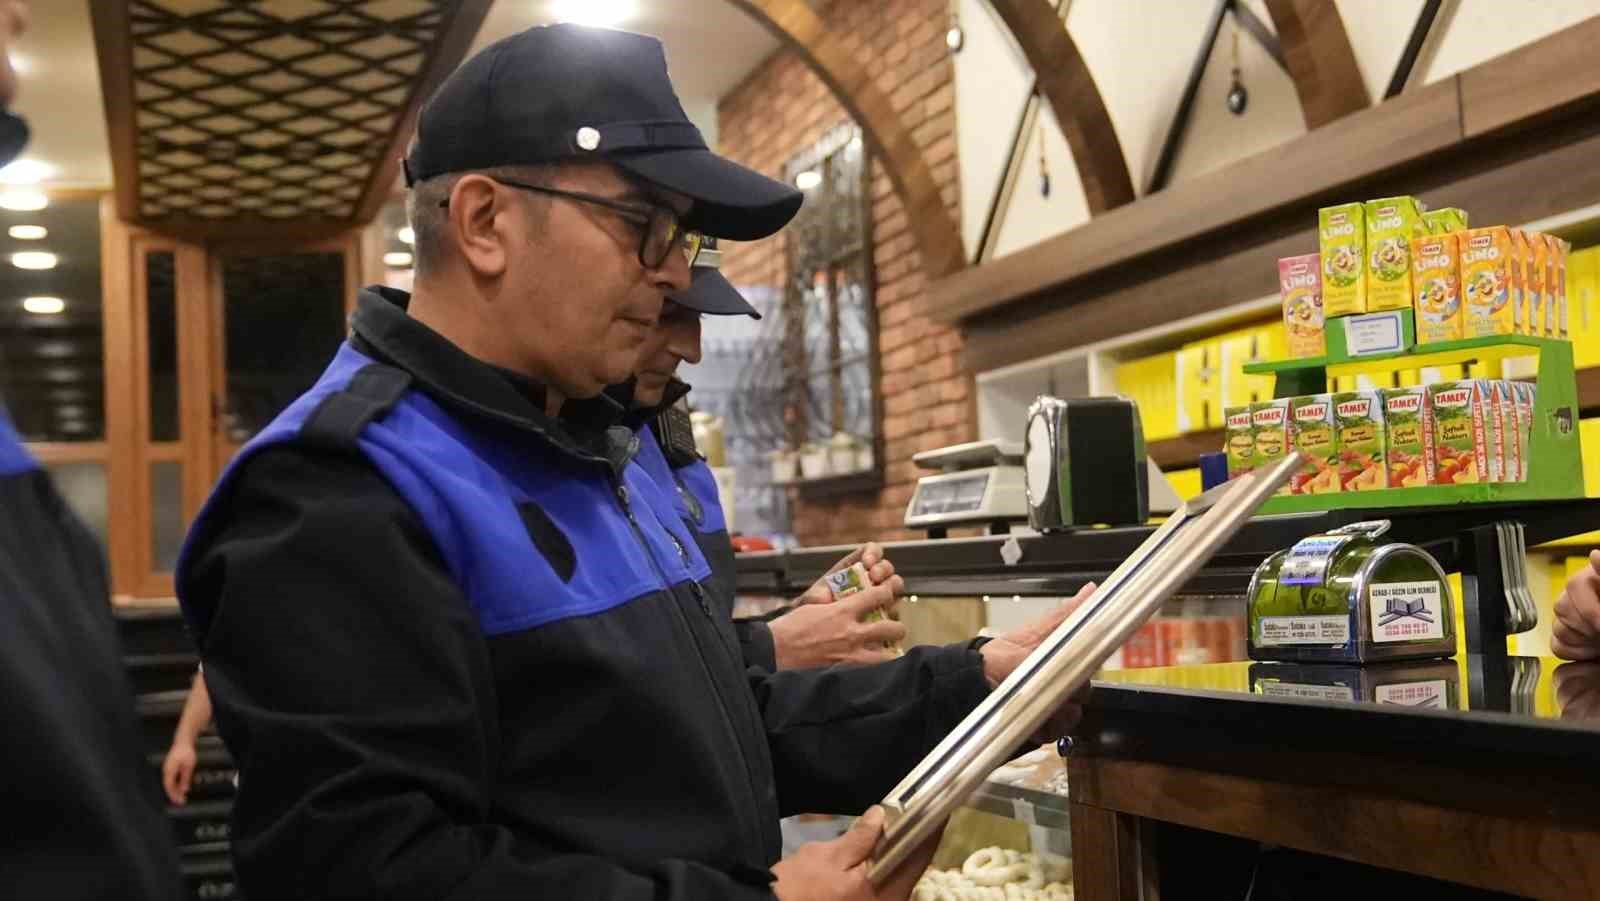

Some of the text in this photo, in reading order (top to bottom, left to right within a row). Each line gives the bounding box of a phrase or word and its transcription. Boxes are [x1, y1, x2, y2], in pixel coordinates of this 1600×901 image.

[1388, 397, 1418, 409] TAMEK
[1436, 391, 1467, 403] TAMEK
[1297, 406, 1325, 418] TAMEK
[1338, 402, 1368, 413] TAMEK
[1228, 414, 1249, 426] TAME
[1254, 410, 1282, 421] TAMEK
